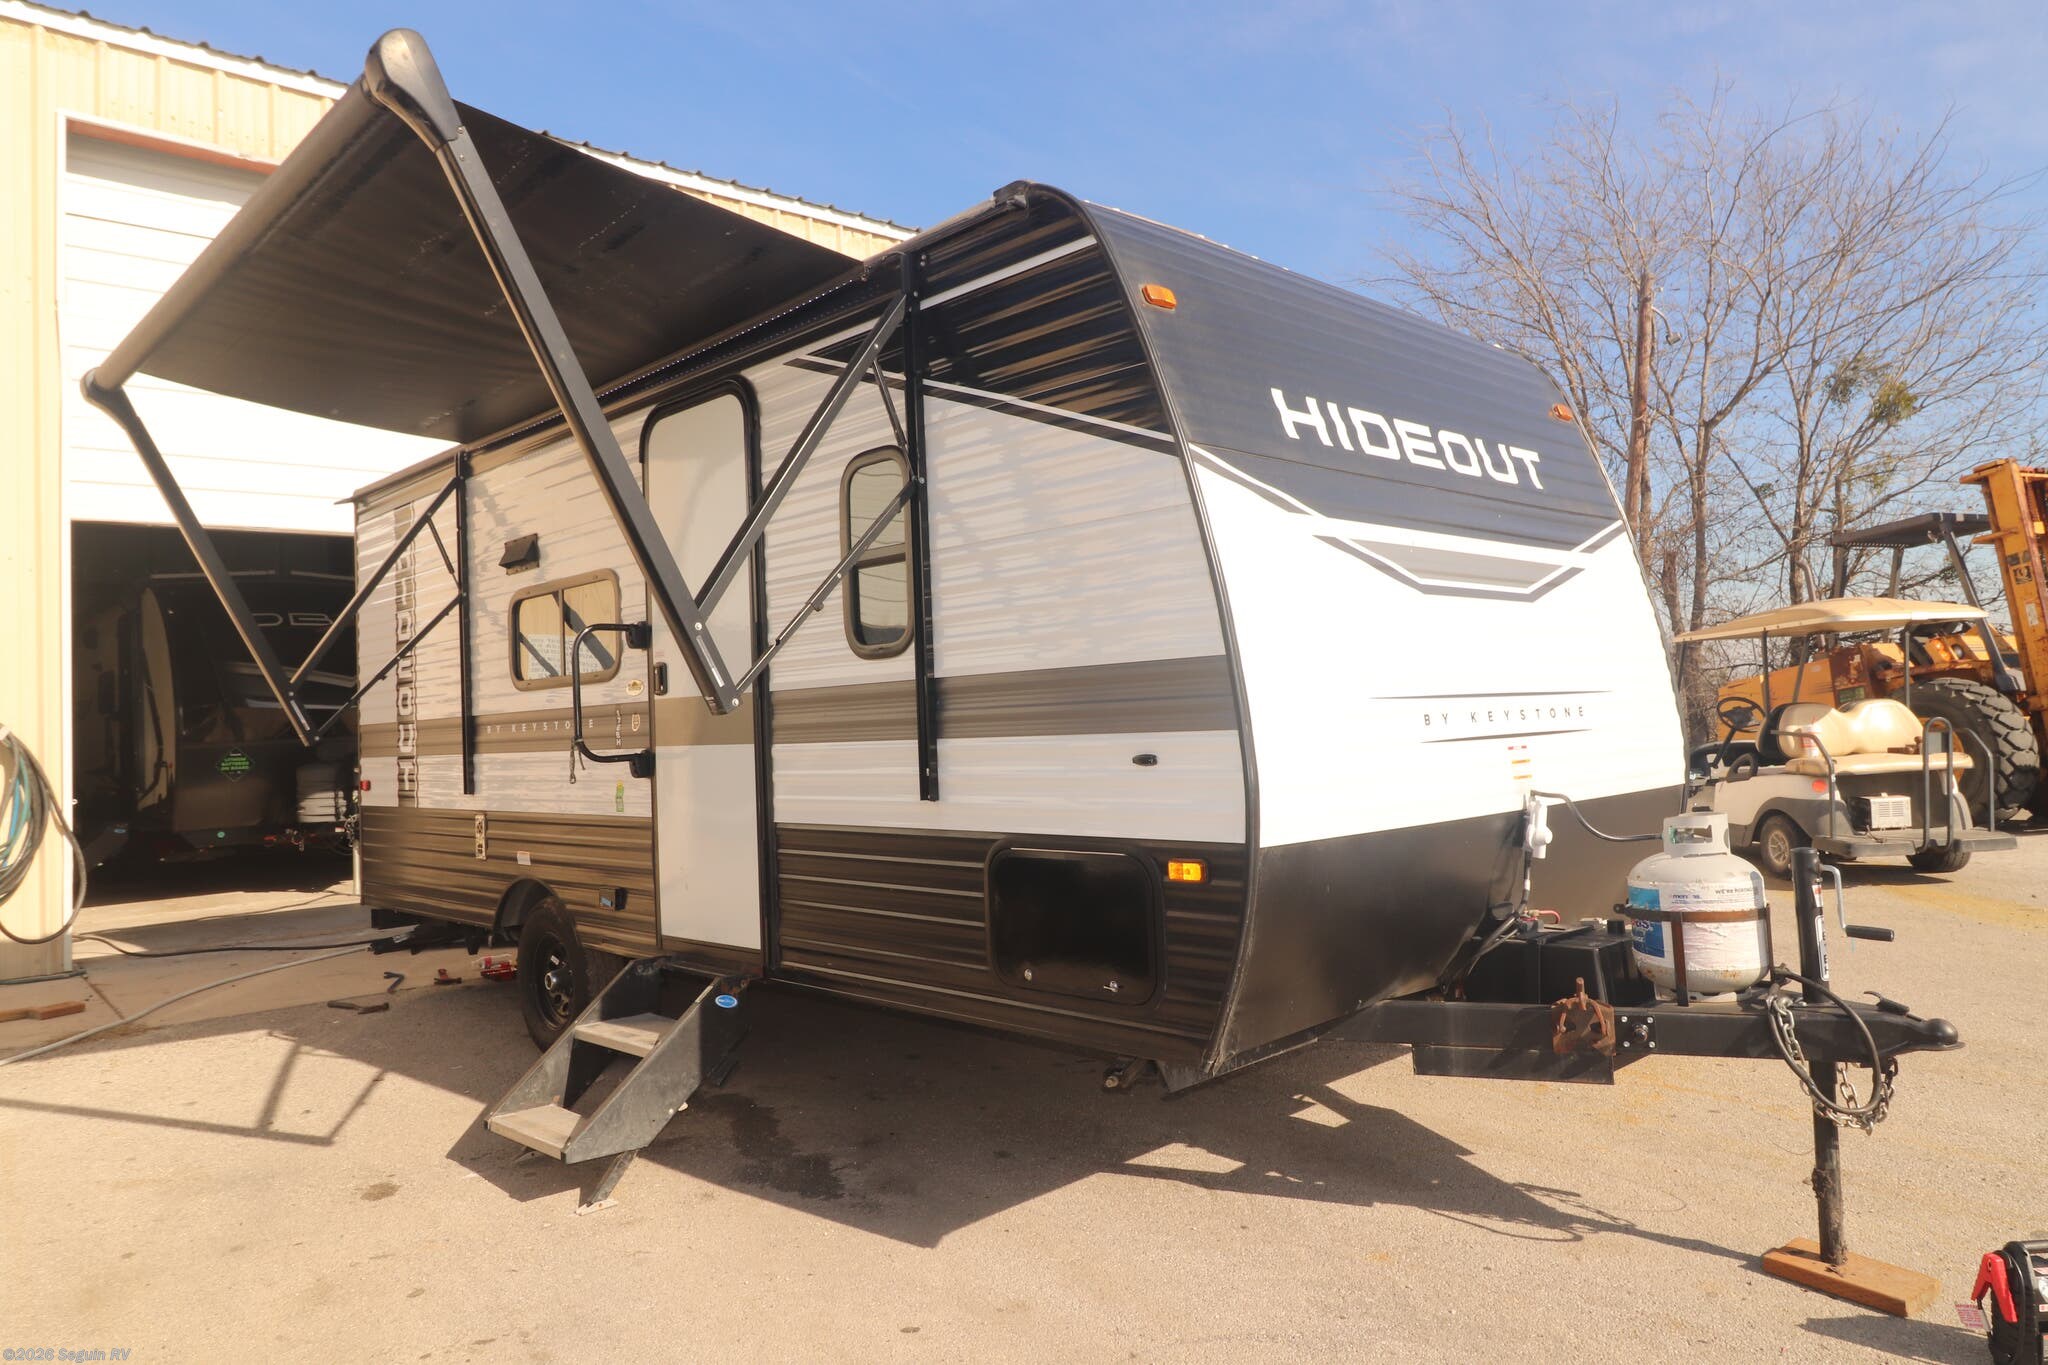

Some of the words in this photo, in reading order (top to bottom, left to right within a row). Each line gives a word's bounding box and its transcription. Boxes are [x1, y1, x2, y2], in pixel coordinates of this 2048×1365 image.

[1270, 387, 1544, 490] HIDEOUT
[511, 718, 594, 734] KEYSTOE
[1423, 713, 1449, 726] BY
[1470, 705, 1585, 724] KEYSTONE
